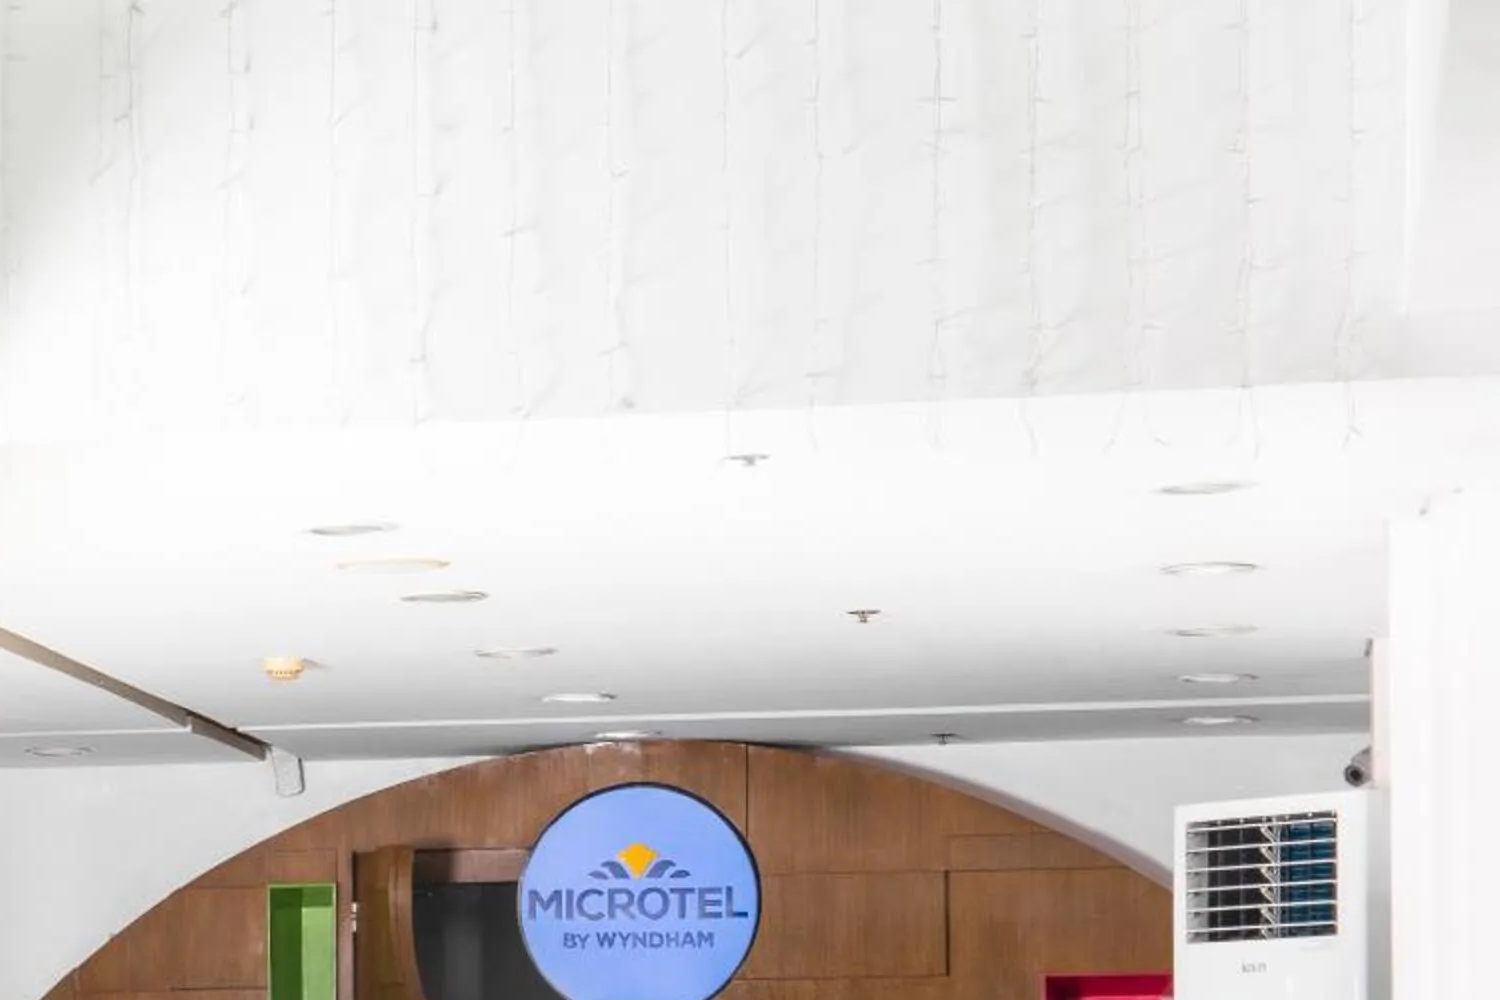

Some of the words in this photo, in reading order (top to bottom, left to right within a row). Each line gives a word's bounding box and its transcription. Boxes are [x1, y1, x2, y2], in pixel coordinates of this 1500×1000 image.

[528, 886, 749, 921] MICROTEL
[562, 932, 590, 949] BY
[596, 931, 715, 949] WYNDHAM
